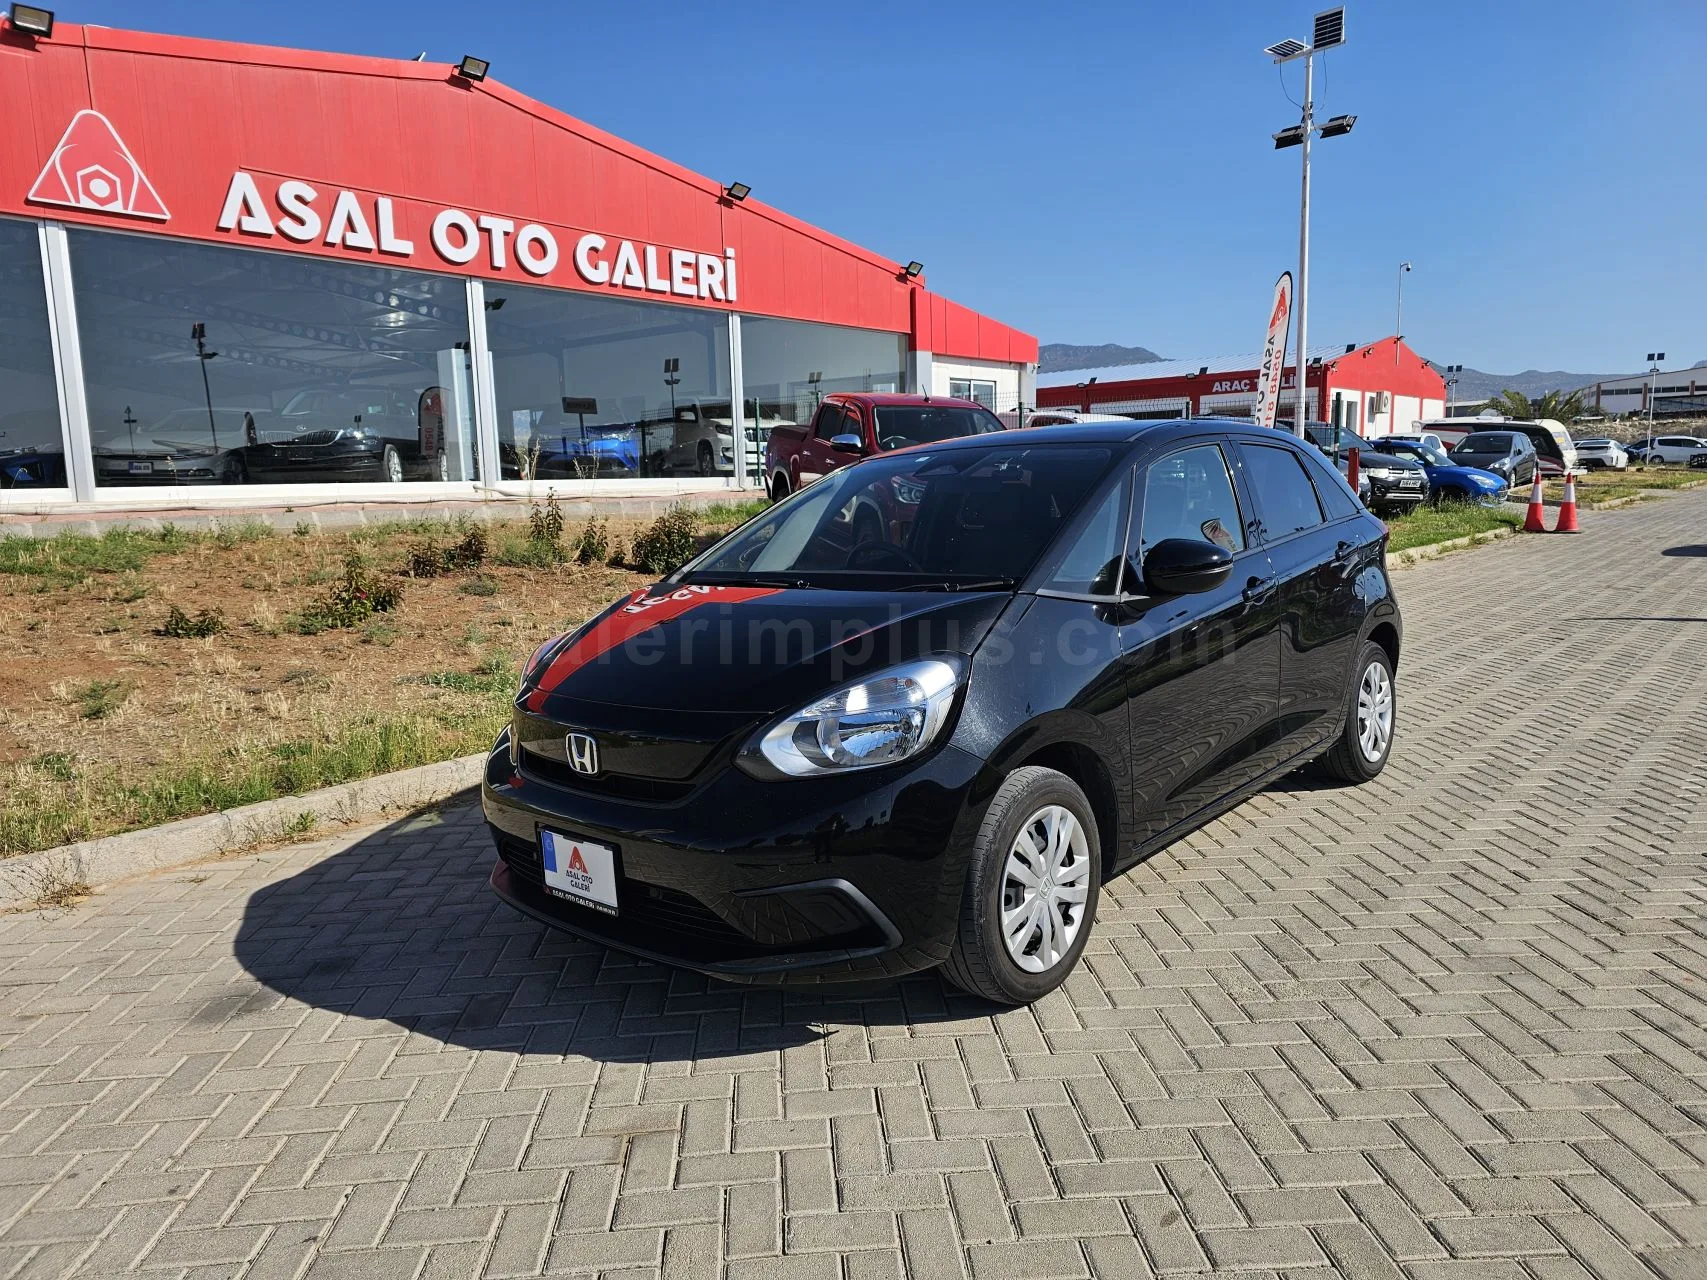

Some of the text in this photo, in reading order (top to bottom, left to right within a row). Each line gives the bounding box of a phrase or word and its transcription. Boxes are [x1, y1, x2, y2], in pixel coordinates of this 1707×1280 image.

[218, 171, 737, 302] ASAL OTO GALERİ
[1212, 379, 1250, 392] ARAÇ
[565, 869, 593, 884] ASAL OTO
